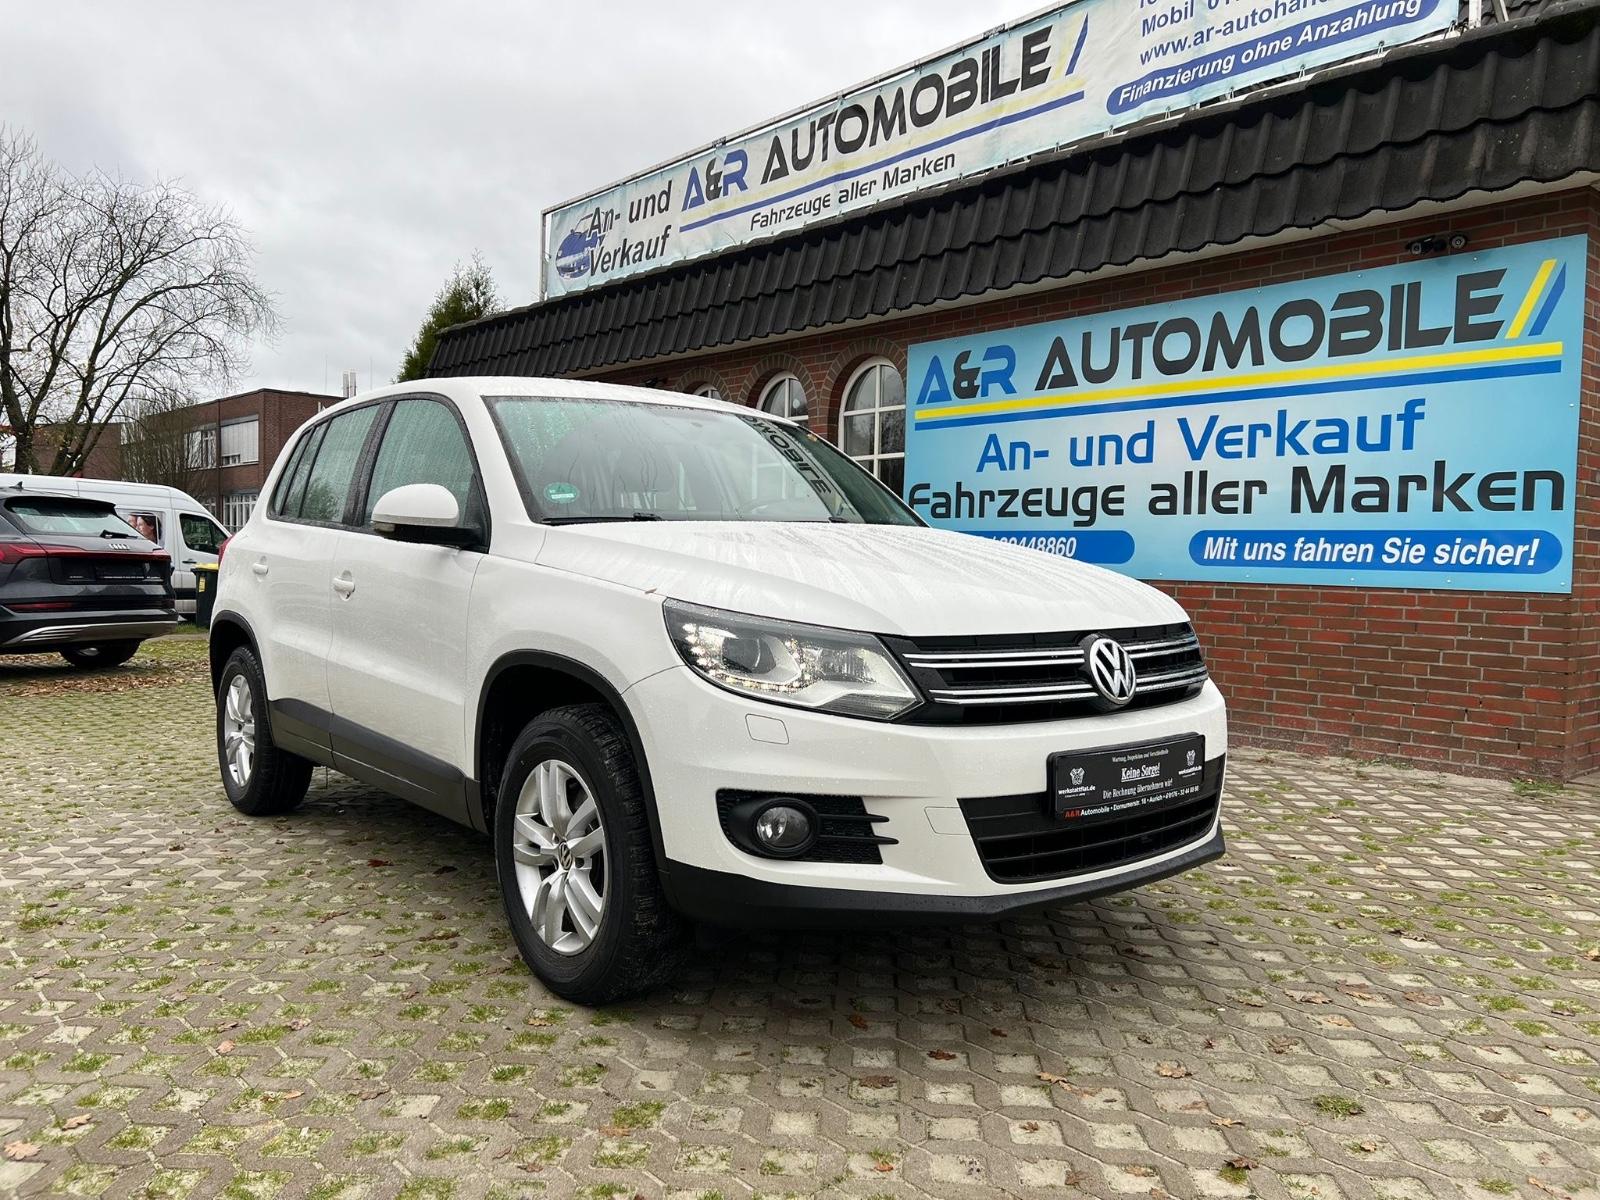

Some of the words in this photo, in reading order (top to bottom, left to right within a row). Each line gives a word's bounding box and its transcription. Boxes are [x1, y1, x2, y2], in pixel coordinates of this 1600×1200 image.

[1139, 0, 1327, 66] www.ar-autoha
[1141, 1, 1194, 37] Mobil
[1118, 55, 1236, 106] Finanzierung
[1241, 35, 1293, 64] ohne
[1296, 0, 1422, 46] Anzahlung
[681, 149, 749, 212] A&R
[760, 24, 1053, 185] AUTOMOBILE
[588, 207, 621, 238] An-
[628, 180, 673, 224] und
[750, 193, 831, 231] Fahrzeuge
[838, 180, 877, 204] aller
[882, 153, 955, 191] Marken
[590, 224, 672, 276] Verkauf
[916, 344, 1017, 405] A&R
[1034, 268, 1507, 391] AUTOMOBILE
[975, 433, 1049, 473] An-
[1069, 420, 1155, 467] und
[1177, 398, 1426, 461] Verkauf
[909, 481, 1125, 527] Fahrzeuge
[1148, 470, 1268, 516] aller
[1290, 460, 1565, 513] Marken
[1203, 536, 1238, 560] Mit
[1243, 541, 1287, 561] uns
[1293, 537, 1374, 563] fahren
[1381, 535, 1426, 565] Sie
[1433, 537, 1542, 566] sicher!
[1121, 767, 1140, 780] Keine
